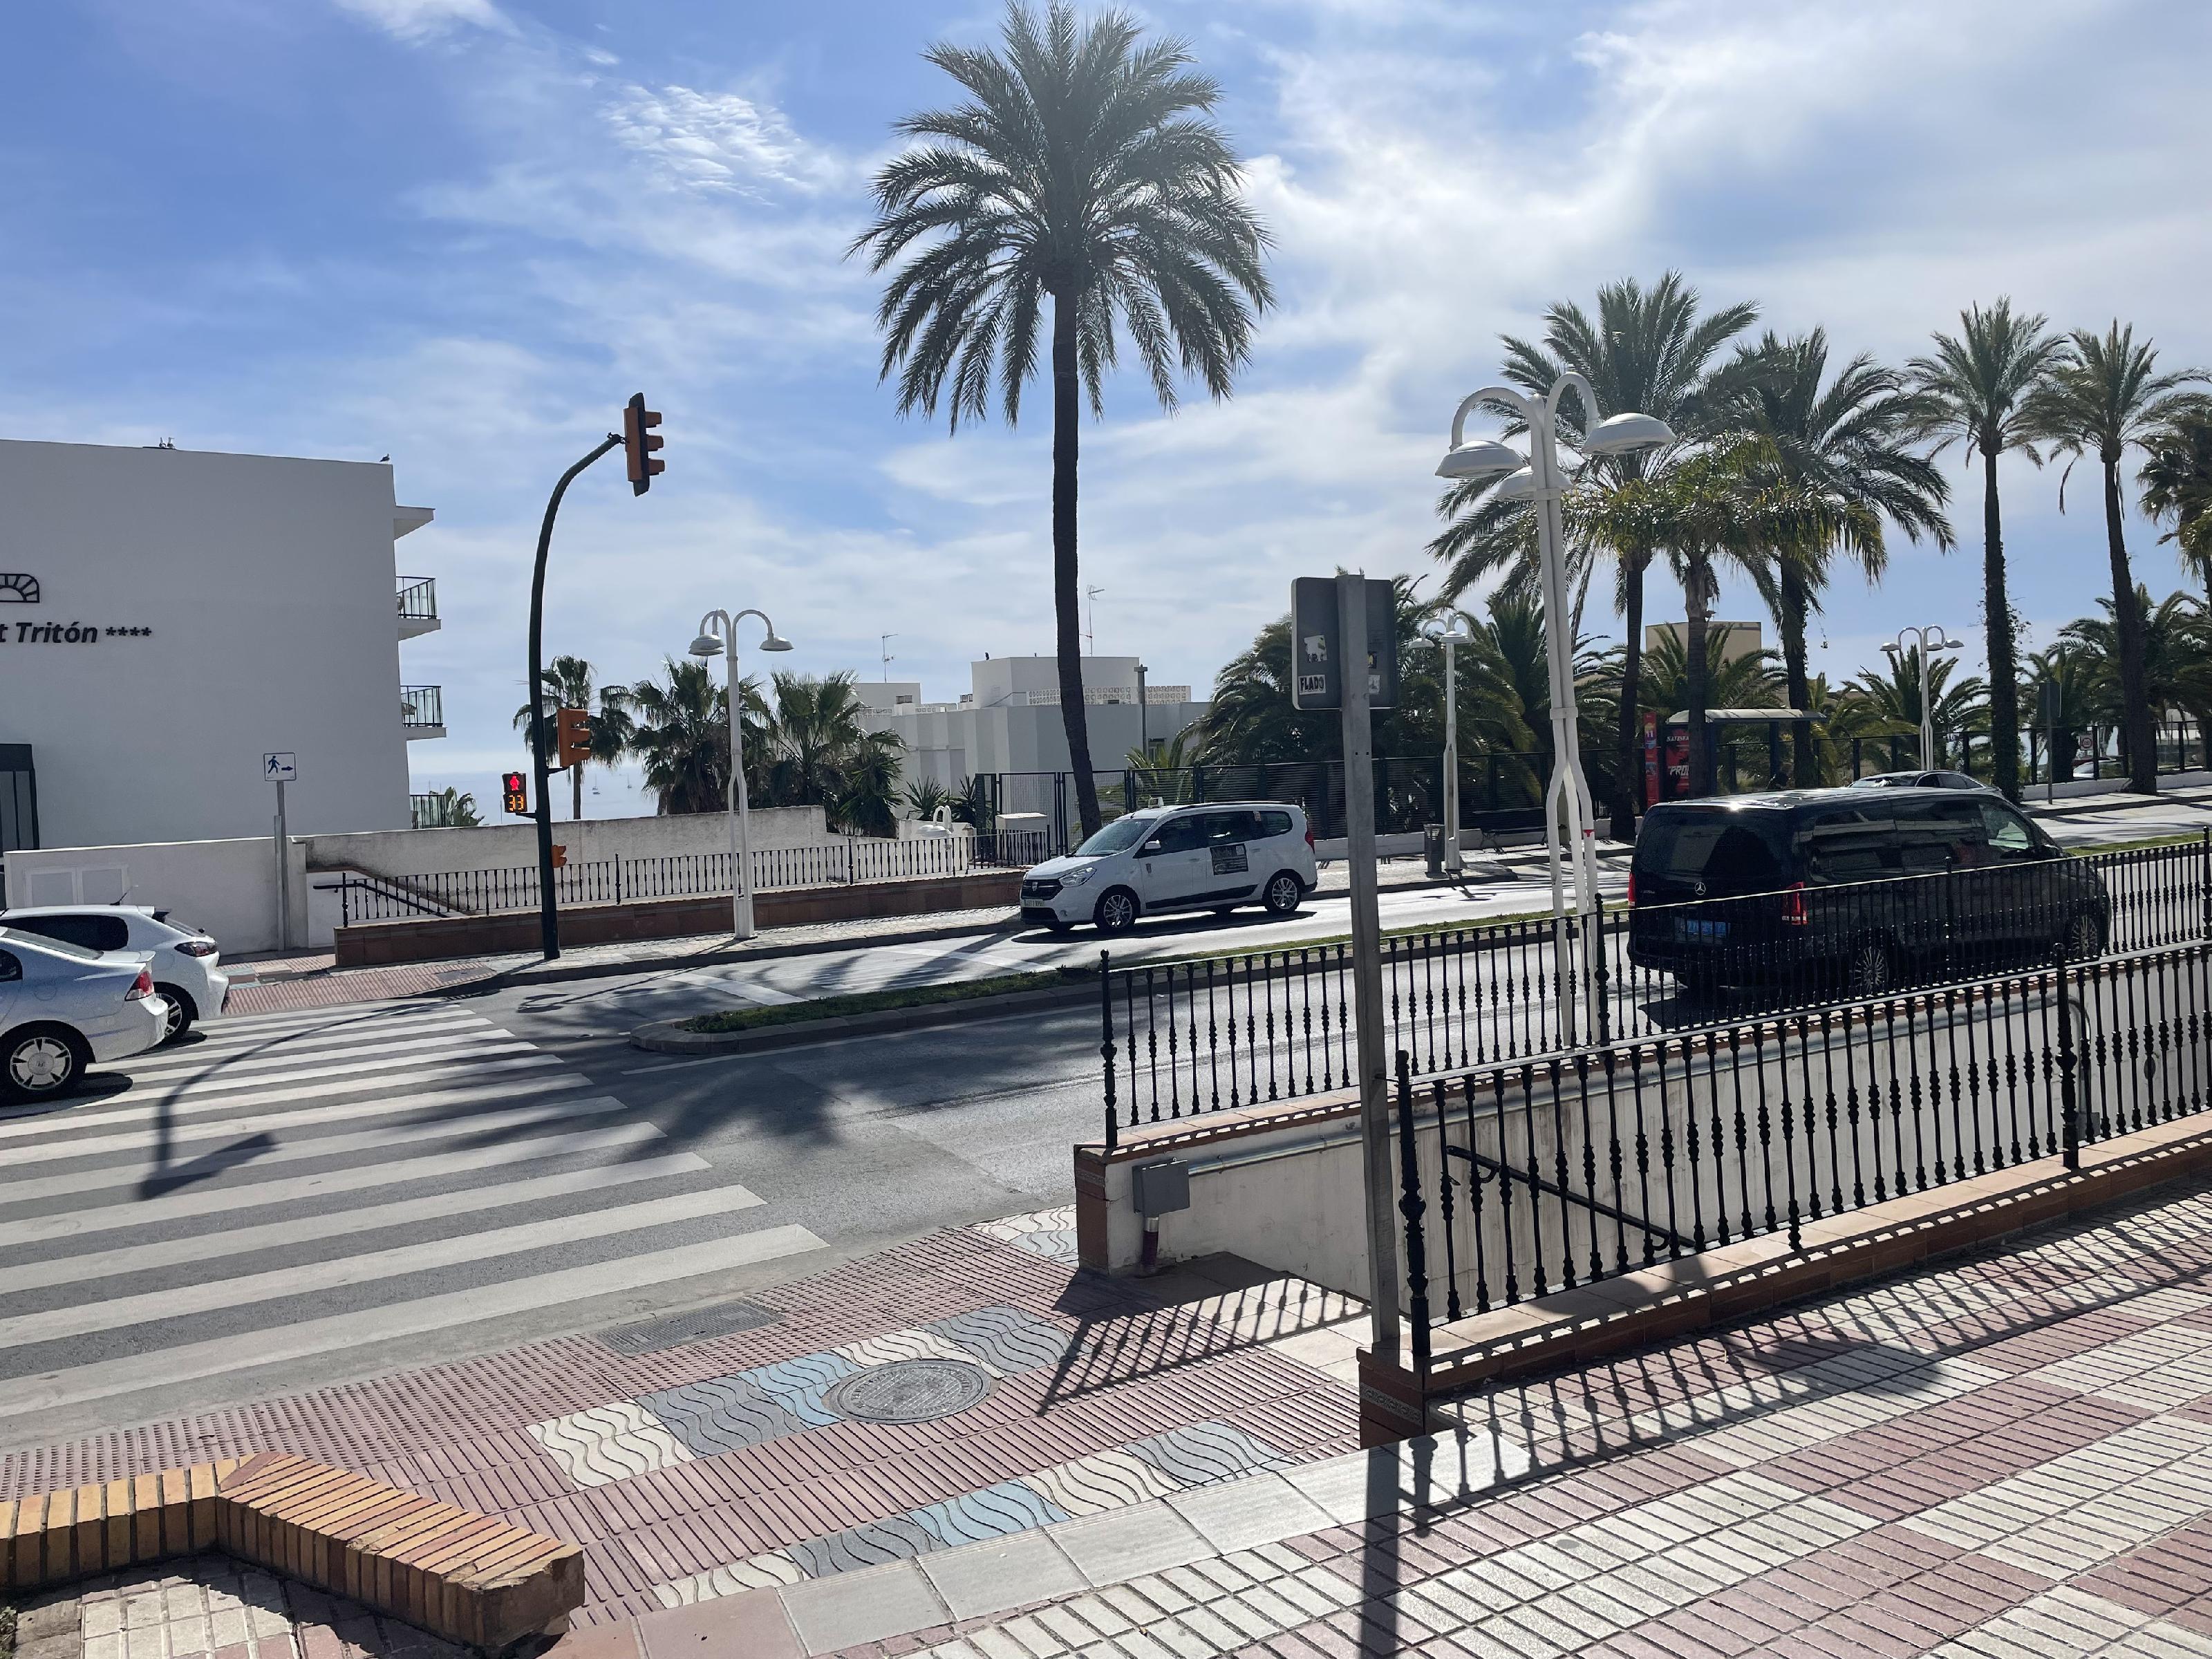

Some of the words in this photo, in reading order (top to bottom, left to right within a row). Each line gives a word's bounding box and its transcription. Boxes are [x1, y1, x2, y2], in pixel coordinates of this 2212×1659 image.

[16, 621, 98, 644] Tritón
[1300, 676, 1324, 691] FLADO
[508, 794, 524, 812] 33
